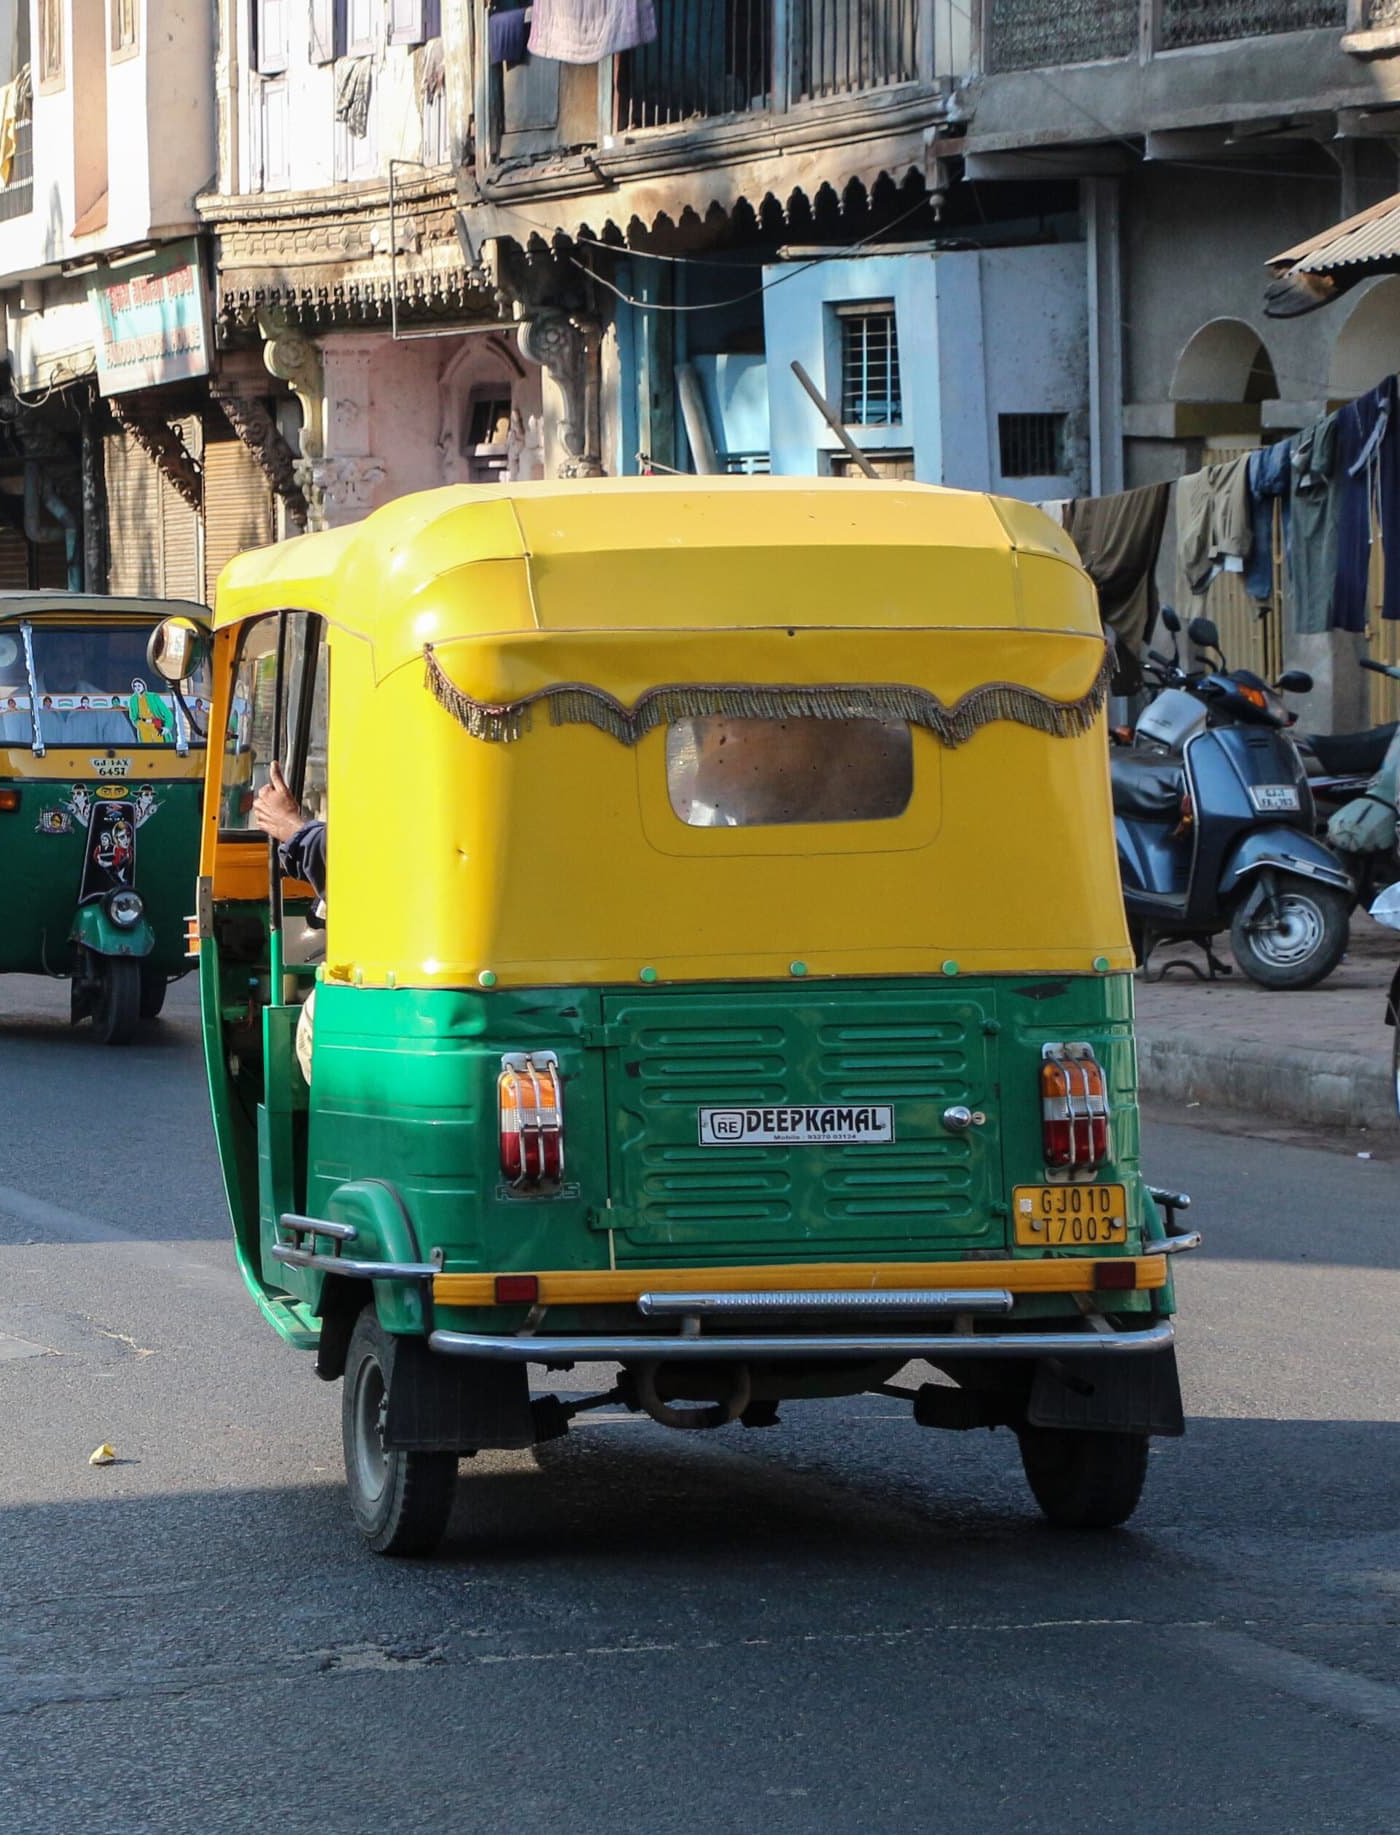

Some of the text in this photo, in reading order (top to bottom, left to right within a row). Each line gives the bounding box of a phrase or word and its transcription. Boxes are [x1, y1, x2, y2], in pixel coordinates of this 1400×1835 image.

[717, 1109, 882, 1134] RE DEEPKAMAL
[1042, 1216, 1113, 1242] T7003
